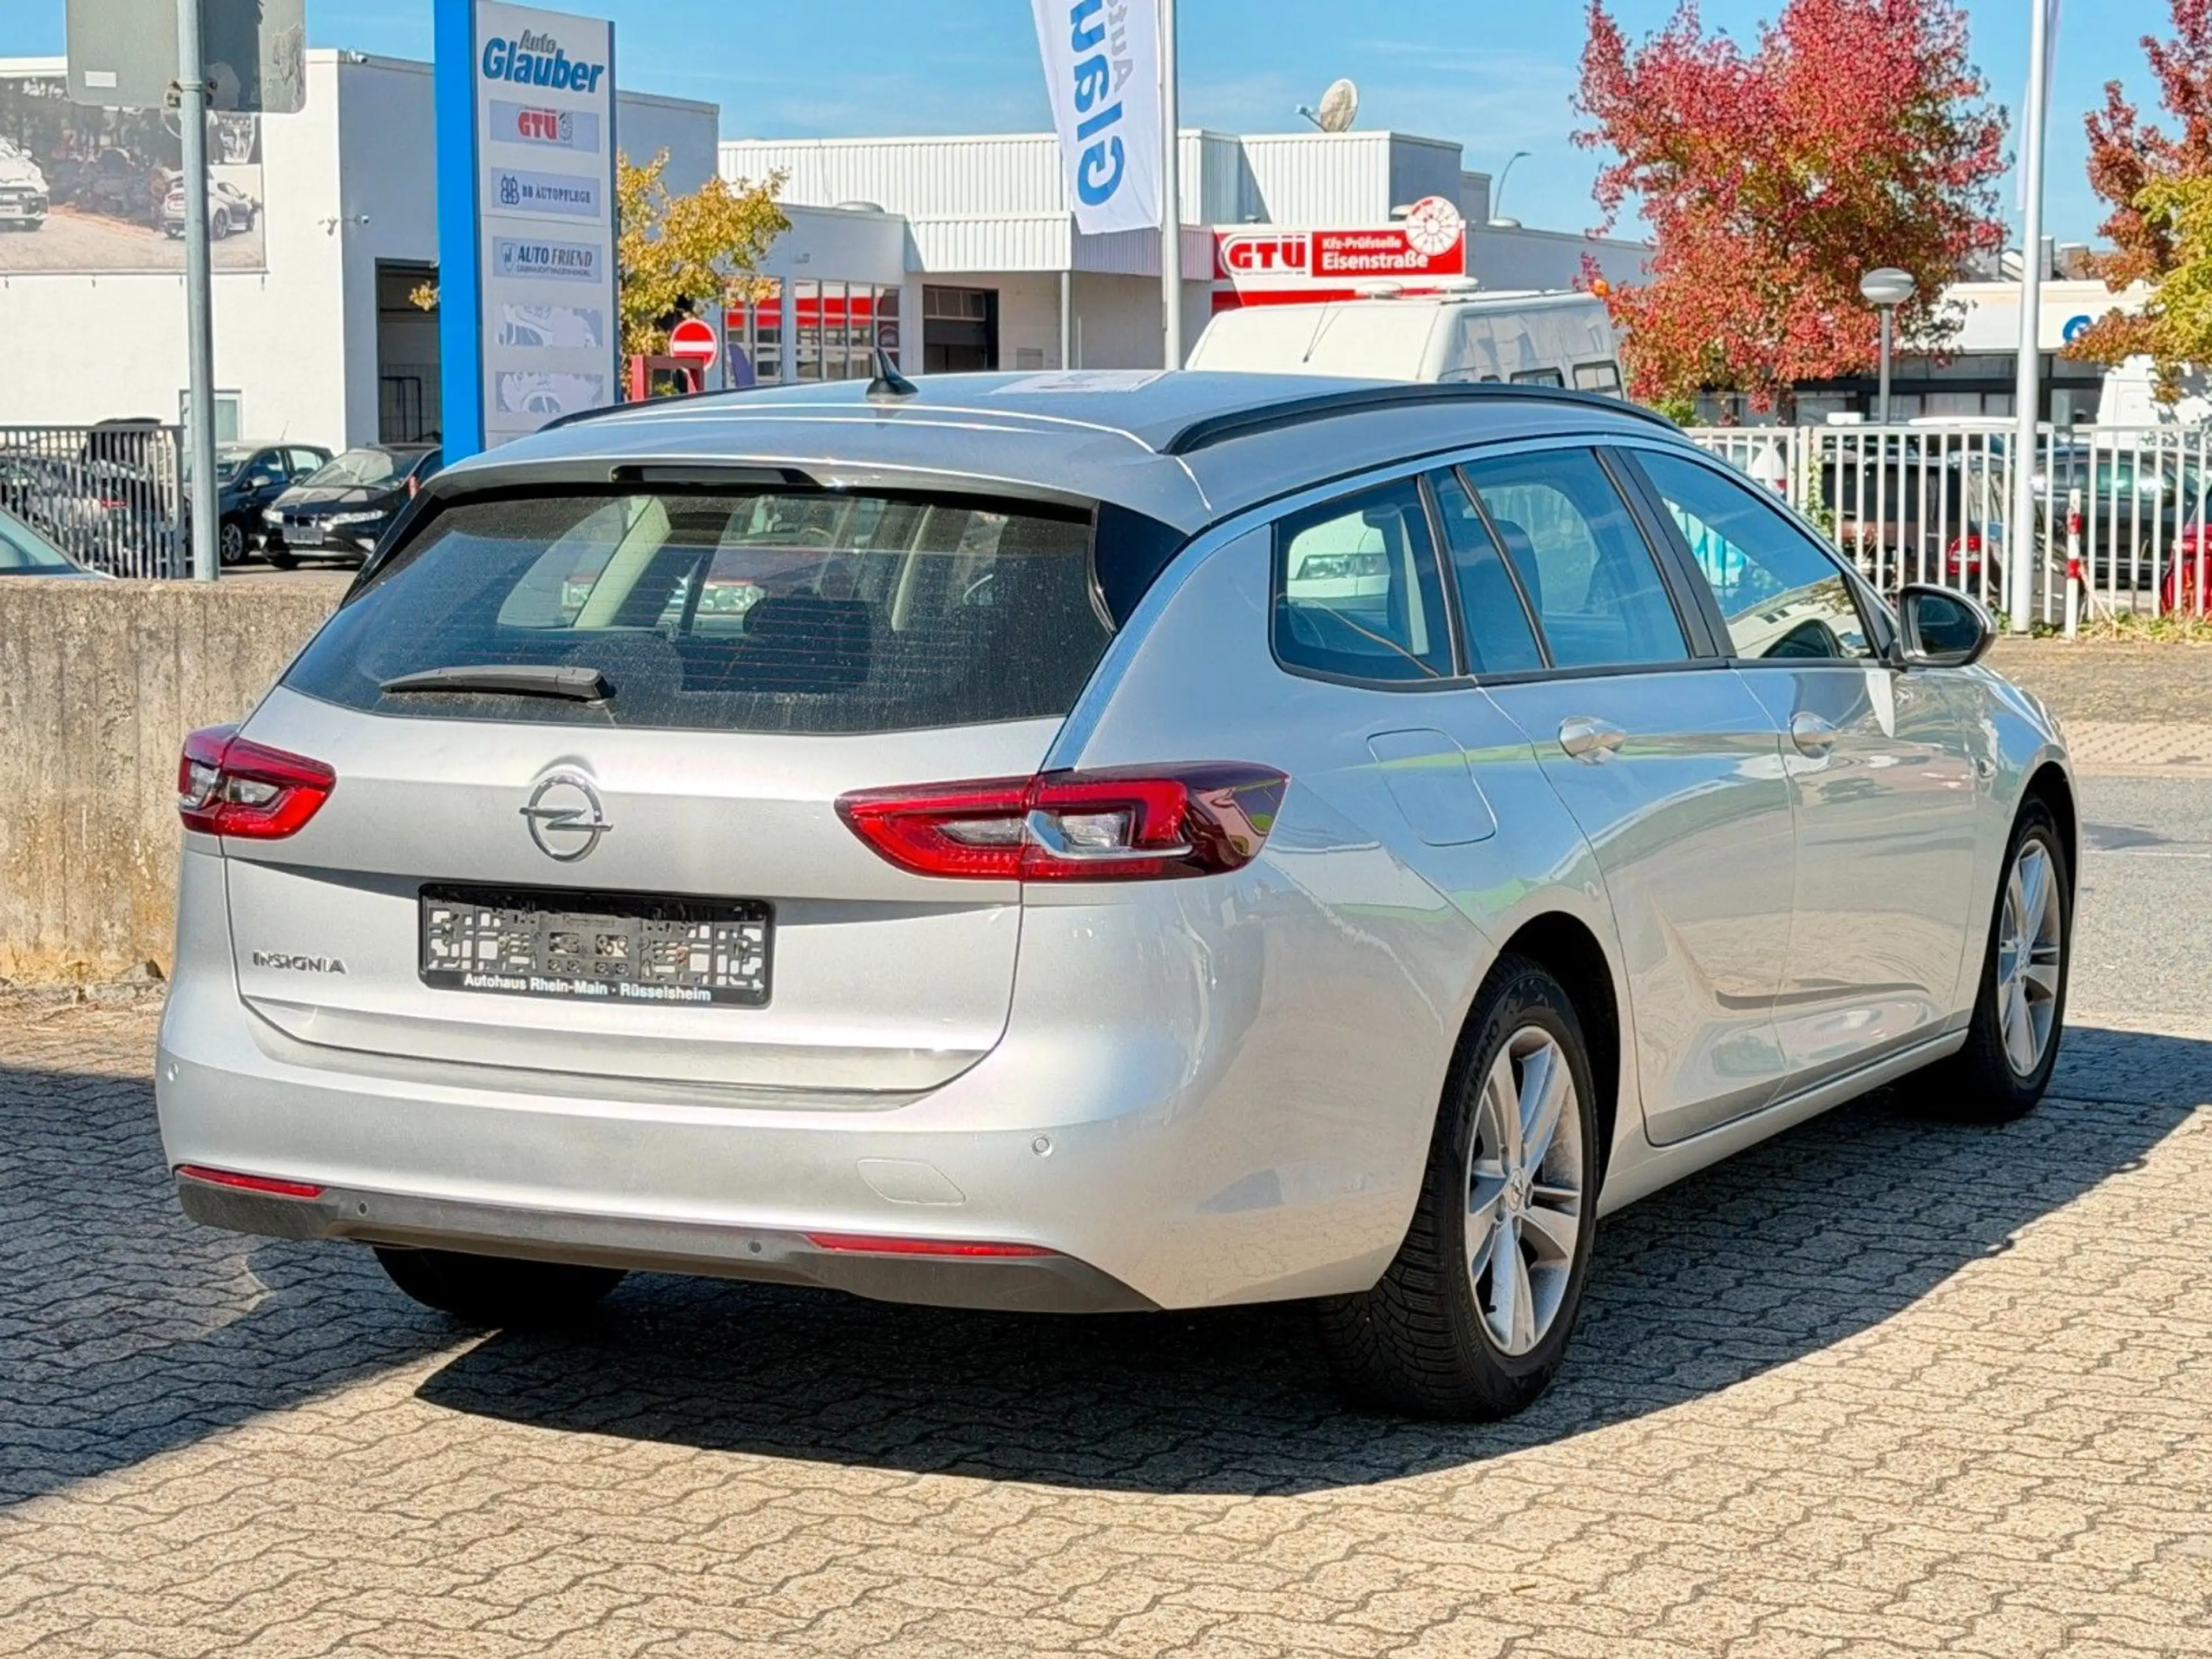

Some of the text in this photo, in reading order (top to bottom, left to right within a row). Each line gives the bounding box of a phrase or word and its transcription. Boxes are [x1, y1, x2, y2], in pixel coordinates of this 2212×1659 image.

[518, 29, 557, 54] Auto
[482, 37, 605, 93] Glauber
[535, 184, 591, 203] AUTOPFLEGE
[1229, 235, 1306, 268] GTÜ
[1322, 236, 1402, 249] Kfz-Prüfstelle
[517, 245, 593, 267] AUTO FRIEND
[1323, 249, 1429, 270] Eisenstraße
[253, 951, 348, 975] INSIGNIA
[464, 973, 711, 1002] Autohaus Rhein-Main Rüsselsheim
